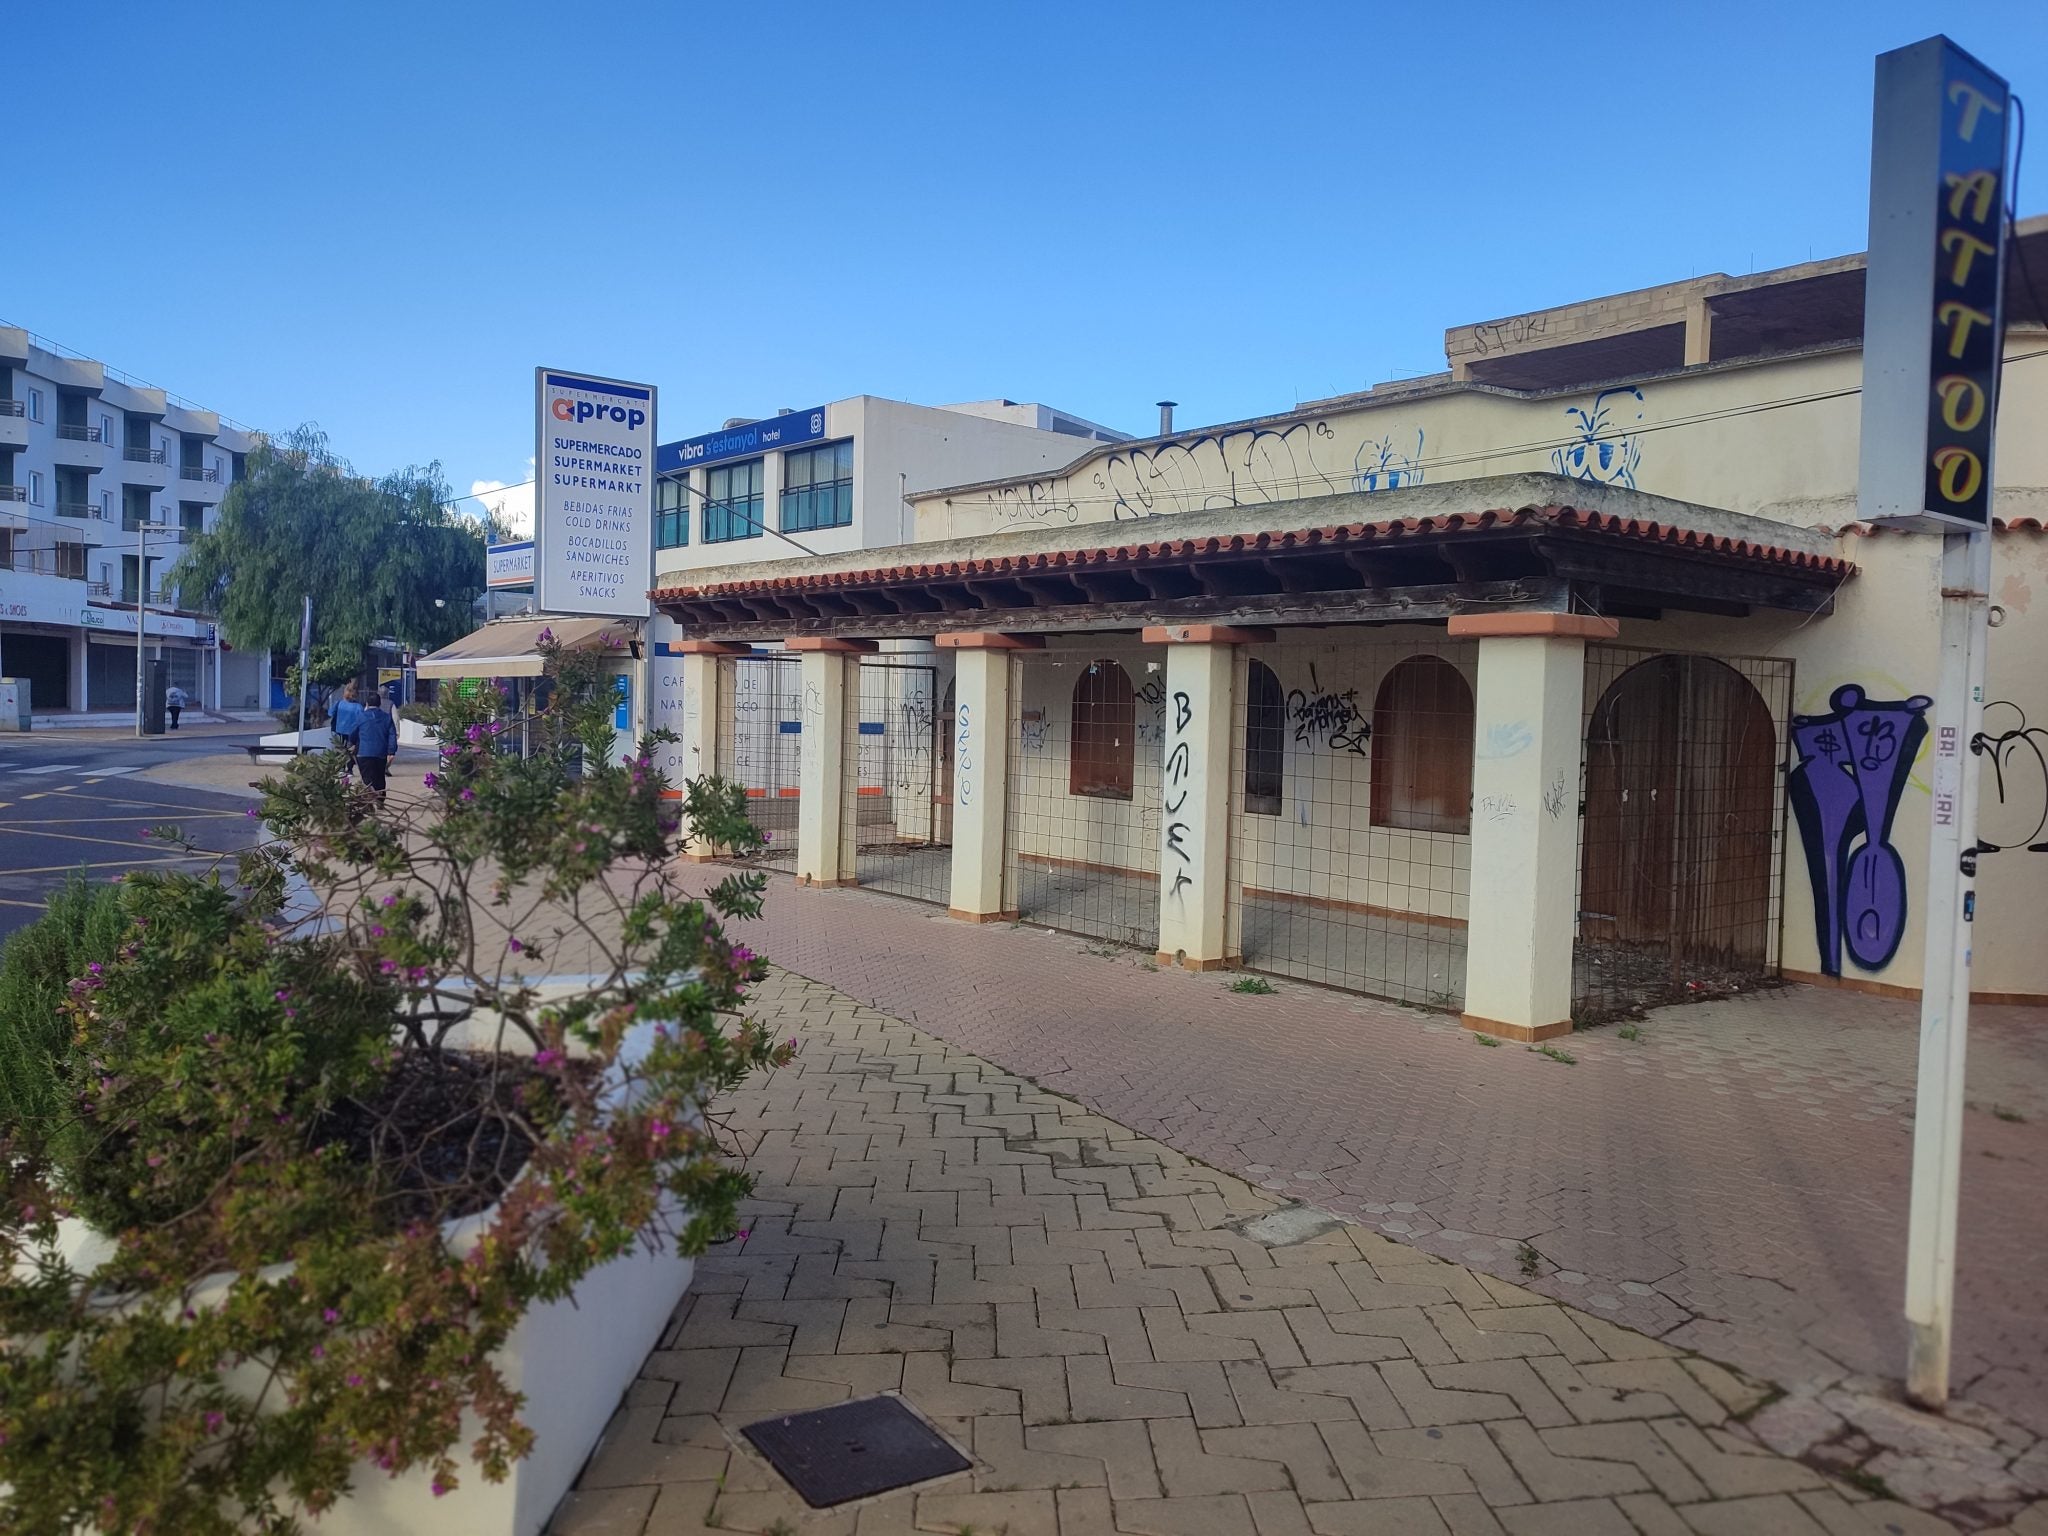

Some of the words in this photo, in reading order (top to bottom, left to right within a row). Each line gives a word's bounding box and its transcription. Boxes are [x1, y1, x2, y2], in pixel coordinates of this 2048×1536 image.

[1932, 79, 2002, 504] TATTOO
[551, 387, 647, 408] SUPERMERCATS
[552, 397, 645, 430] aprop
[554, 437, 642, 460] SUPERMERCADO
[678, 443, 704, 462] vibra
[706, 428, 757, 456] s'estanyol
[762, 428, 781, 443] hotel
[554, 455, 642, 477] SUPERMARKET
[554, 473, 642, 494] SUPERMARKT
[563, 500, 604, 515] BEBIDAS
[607, 504, 633, 518] FRIAS
[565, 516, 591, 529] COLD
[595, 518, 631, 533] DRINKS
[568, 535, 627, 551] BOCADILLOS
[493, 555, 532, 574] SUPERMARKET
[566, 552, 630, 566] SANDWICHES
[570, 571, 625, 585] APERITIVOS
[579, 586, 616, 599] SNACKS
